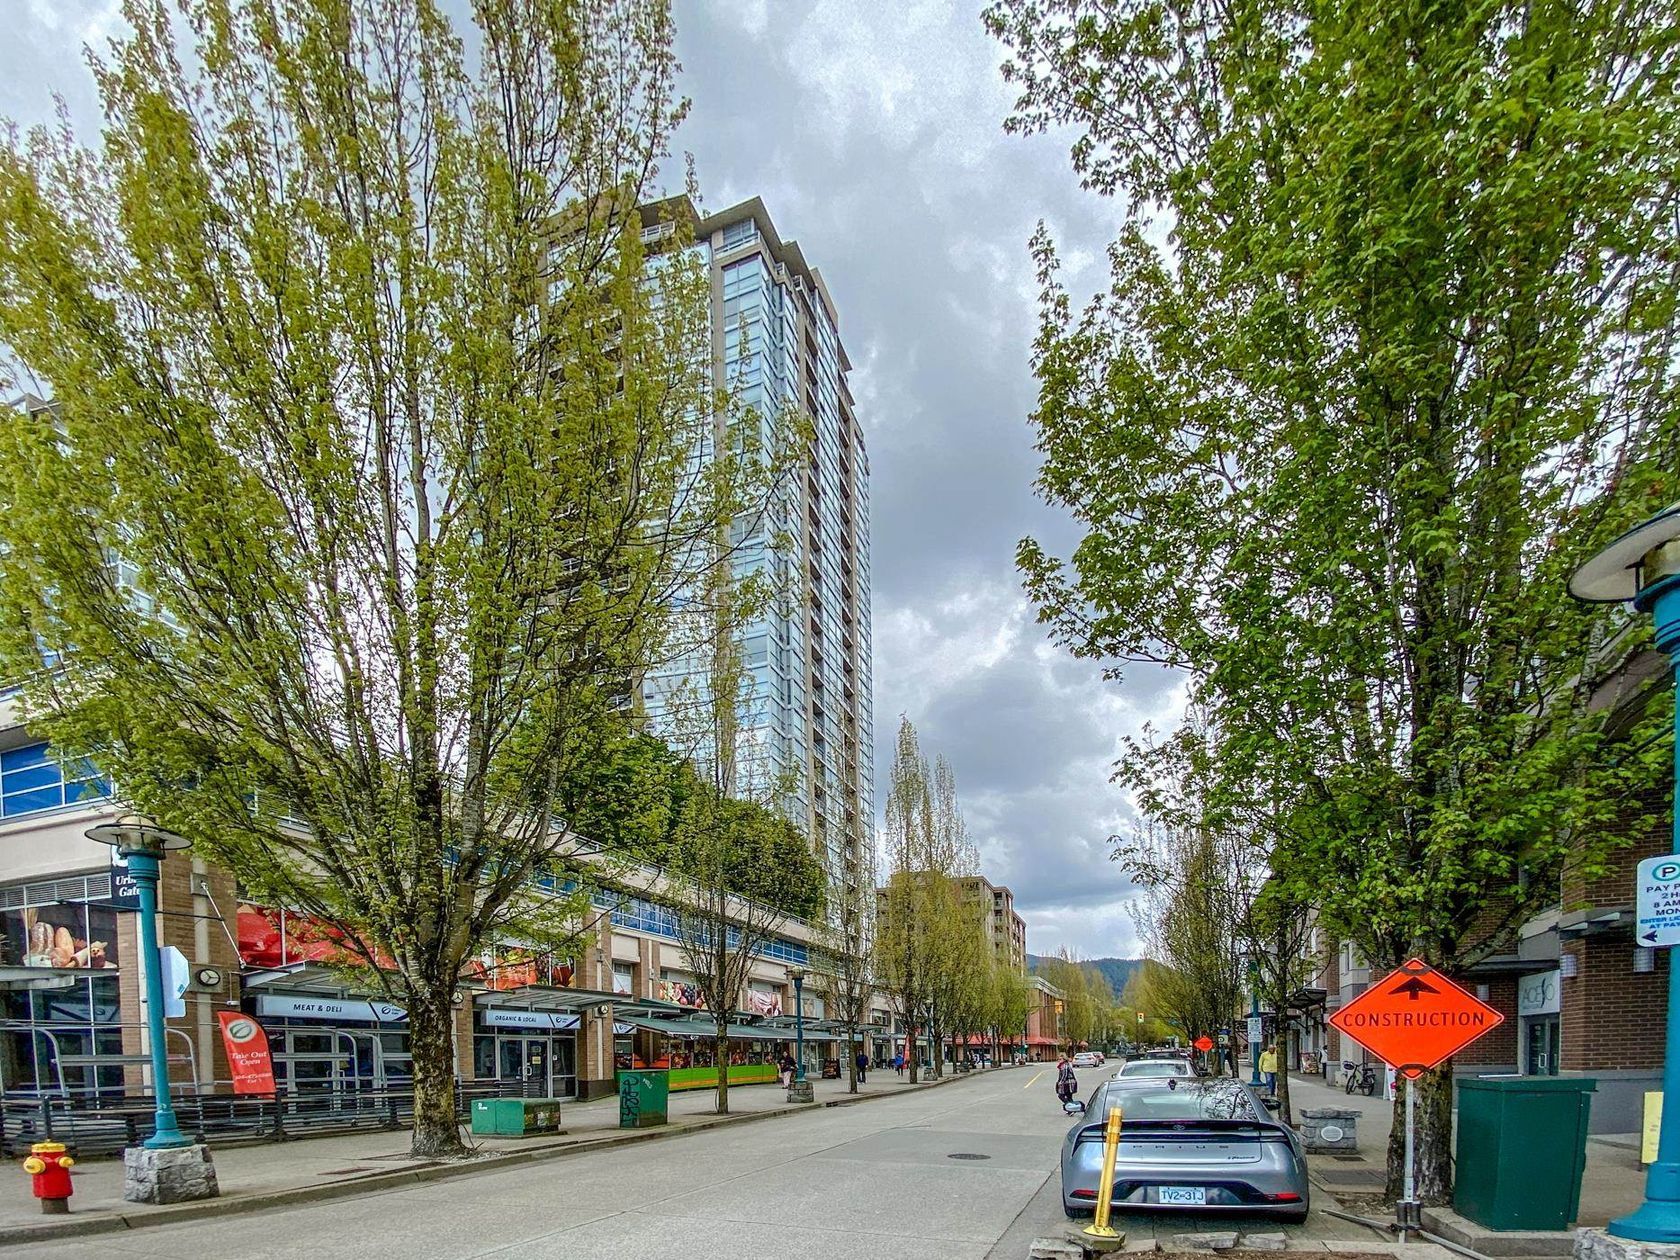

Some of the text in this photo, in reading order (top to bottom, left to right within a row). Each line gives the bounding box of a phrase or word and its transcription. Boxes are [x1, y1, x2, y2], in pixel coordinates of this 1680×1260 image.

[1662, 866, 1676, 877] P
[1646, 885, 1670, 893] PAY
[293, 1003, 315, 1012] MEAT
[325, 1005, 343, 1013] DELI
[1343, 1011, 1485, 1027] CONSTRUCTION
[250, 1051, 267, 1059] Out
[240, 1058, 261, 1067] Open
